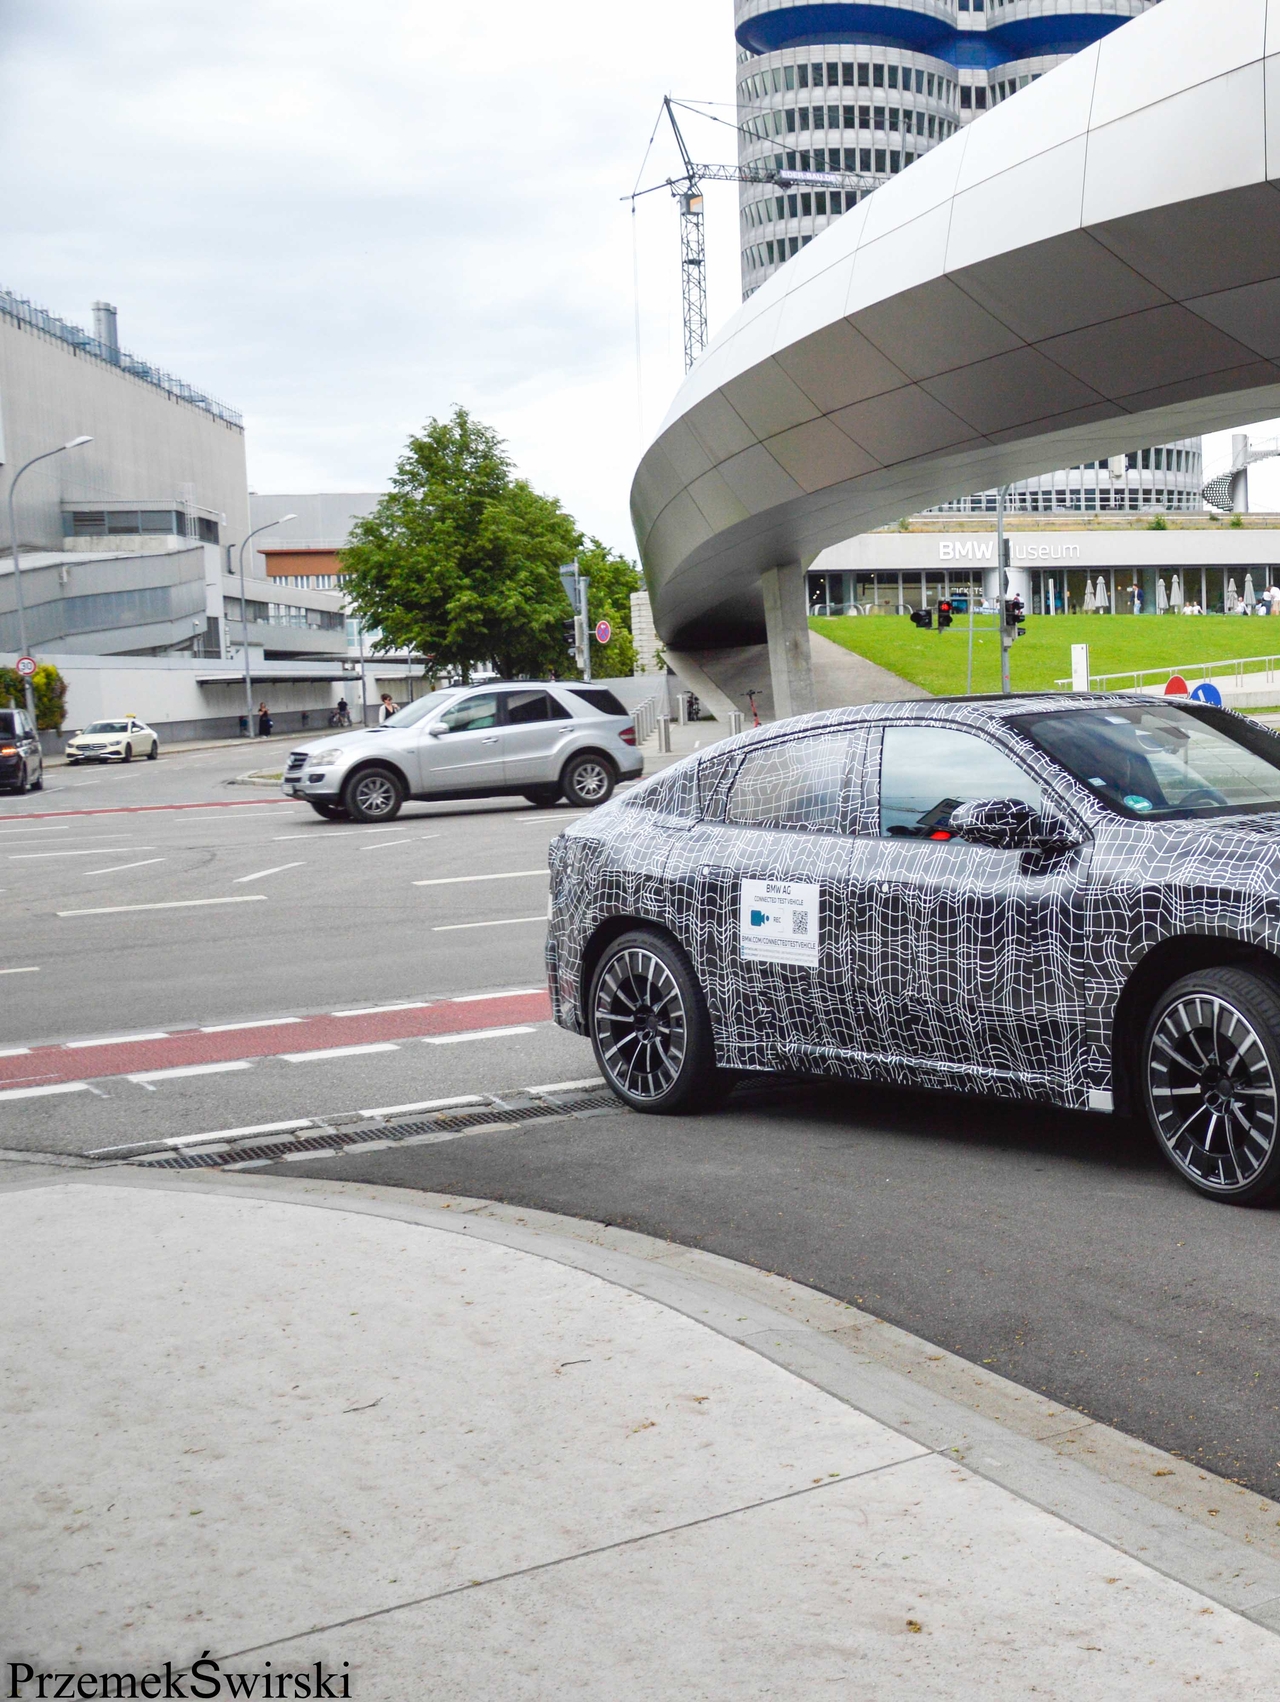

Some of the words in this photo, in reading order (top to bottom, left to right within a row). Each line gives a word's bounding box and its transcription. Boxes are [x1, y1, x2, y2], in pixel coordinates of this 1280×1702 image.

[782, 170, 836, 181] EDER-BAU.DE
[939, 541, 994, 559] BMW
[1009, 541, 1080, 559] useum
[21, 662, 32, 670] 30
[766, 883, 782, 894] BMW
[782, 885, 791, 895] AG
[754, 895, 777, 903] CONNECTED
[787, 898, 803, 906] VEHICLE
